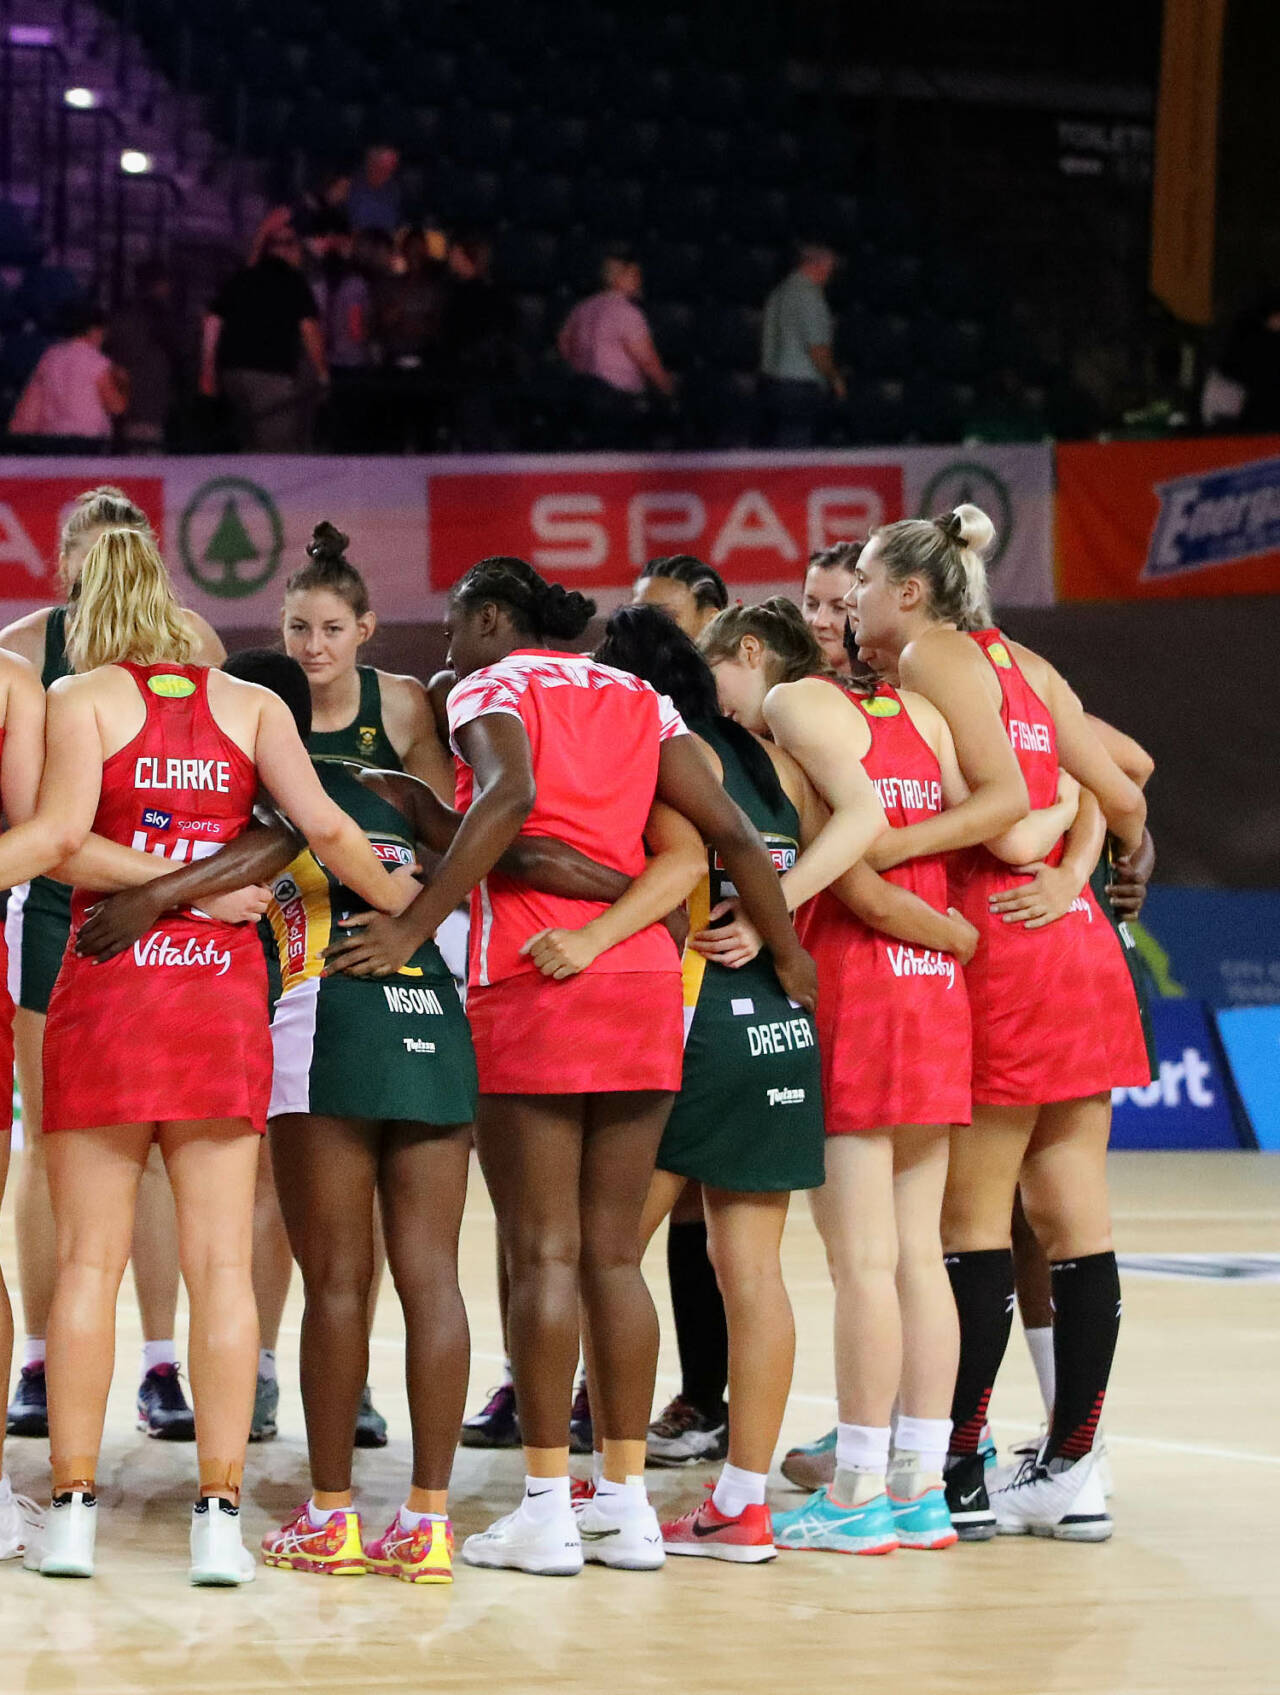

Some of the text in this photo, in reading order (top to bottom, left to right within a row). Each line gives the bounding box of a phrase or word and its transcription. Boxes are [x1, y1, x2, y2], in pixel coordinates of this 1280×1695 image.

[1009, 719, 1051, 754] FISHER
[134, 757, 231, 793] CLARKE
[144, 811, 221, 833] sky sports
[133, 930, 231, 976] Vitality
[383, 985, 444, 1015] MSOMI
[746, 1017, 814, 1056] DREYER
